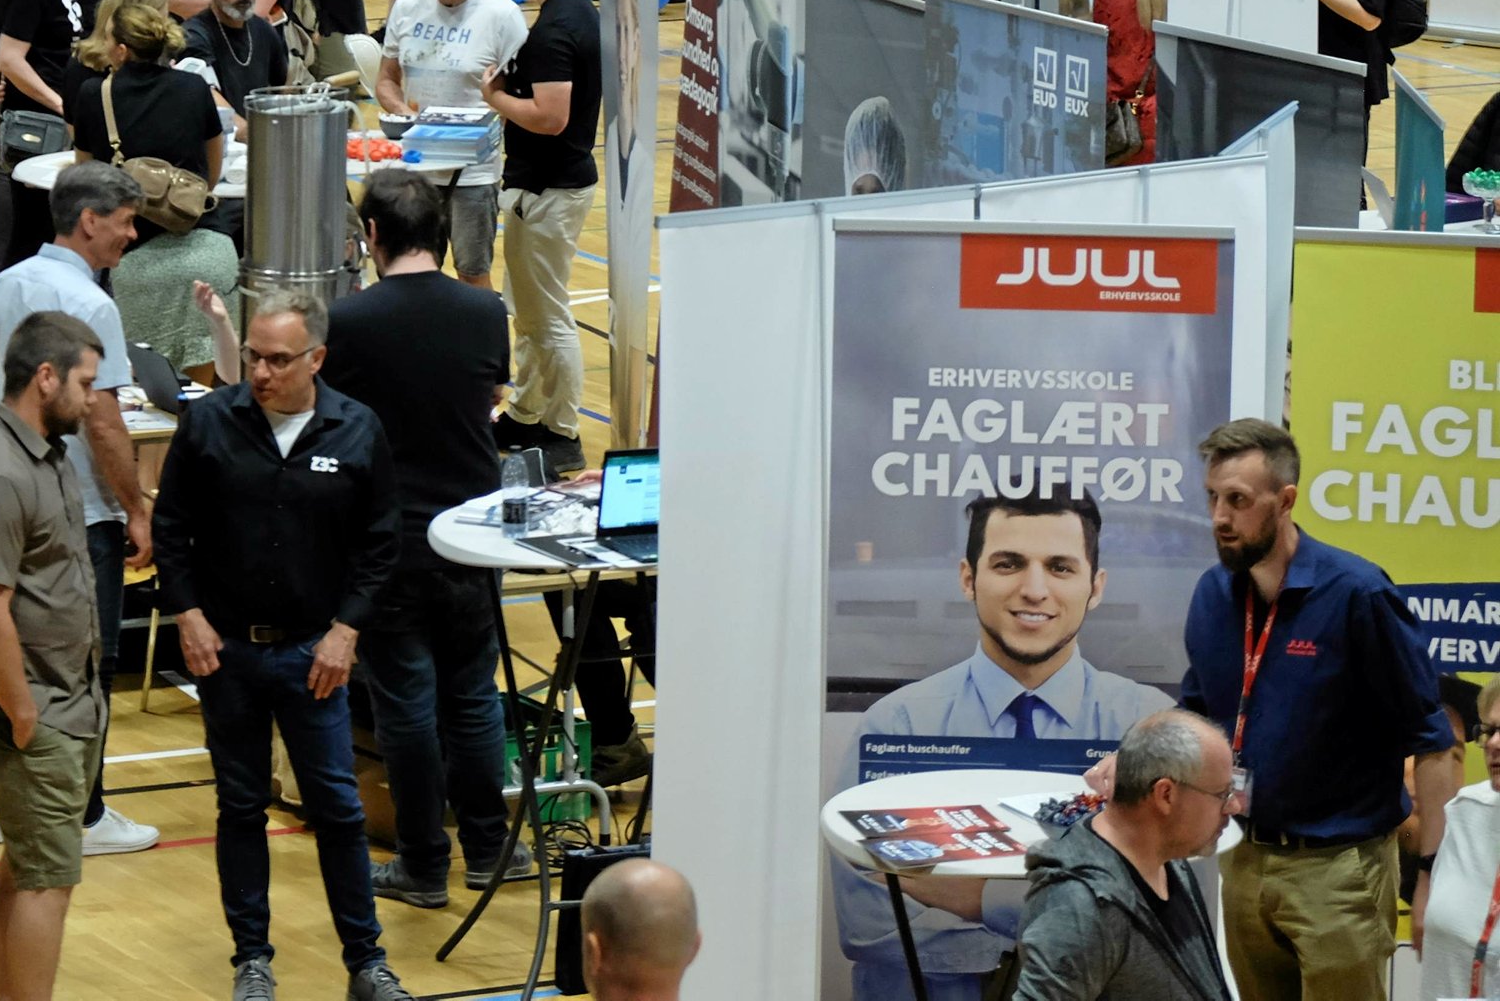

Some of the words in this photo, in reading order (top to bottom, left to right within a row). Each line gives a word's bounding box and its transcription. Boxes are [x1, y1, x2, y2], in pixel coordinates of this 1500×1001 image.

[412, 22, 471, 44] BEACH
[1033, 88, 1057, 109] EUD
[1065, 96, 1089, 118] EUX
[996, 247, 1180, 288] JUUL
[1100, 290, 1181, 302] ERHVERVSSKOLE
[928, 367, 1133, 391] ERHVERVSSKOLE
[892, 397, 1169, 446] FAGLÆRT
[871, 452, 1184, 503] CHAUFFØR
[865, 742, 906, 755] Faglært
[907, 744, 971, 756] buschauffør
